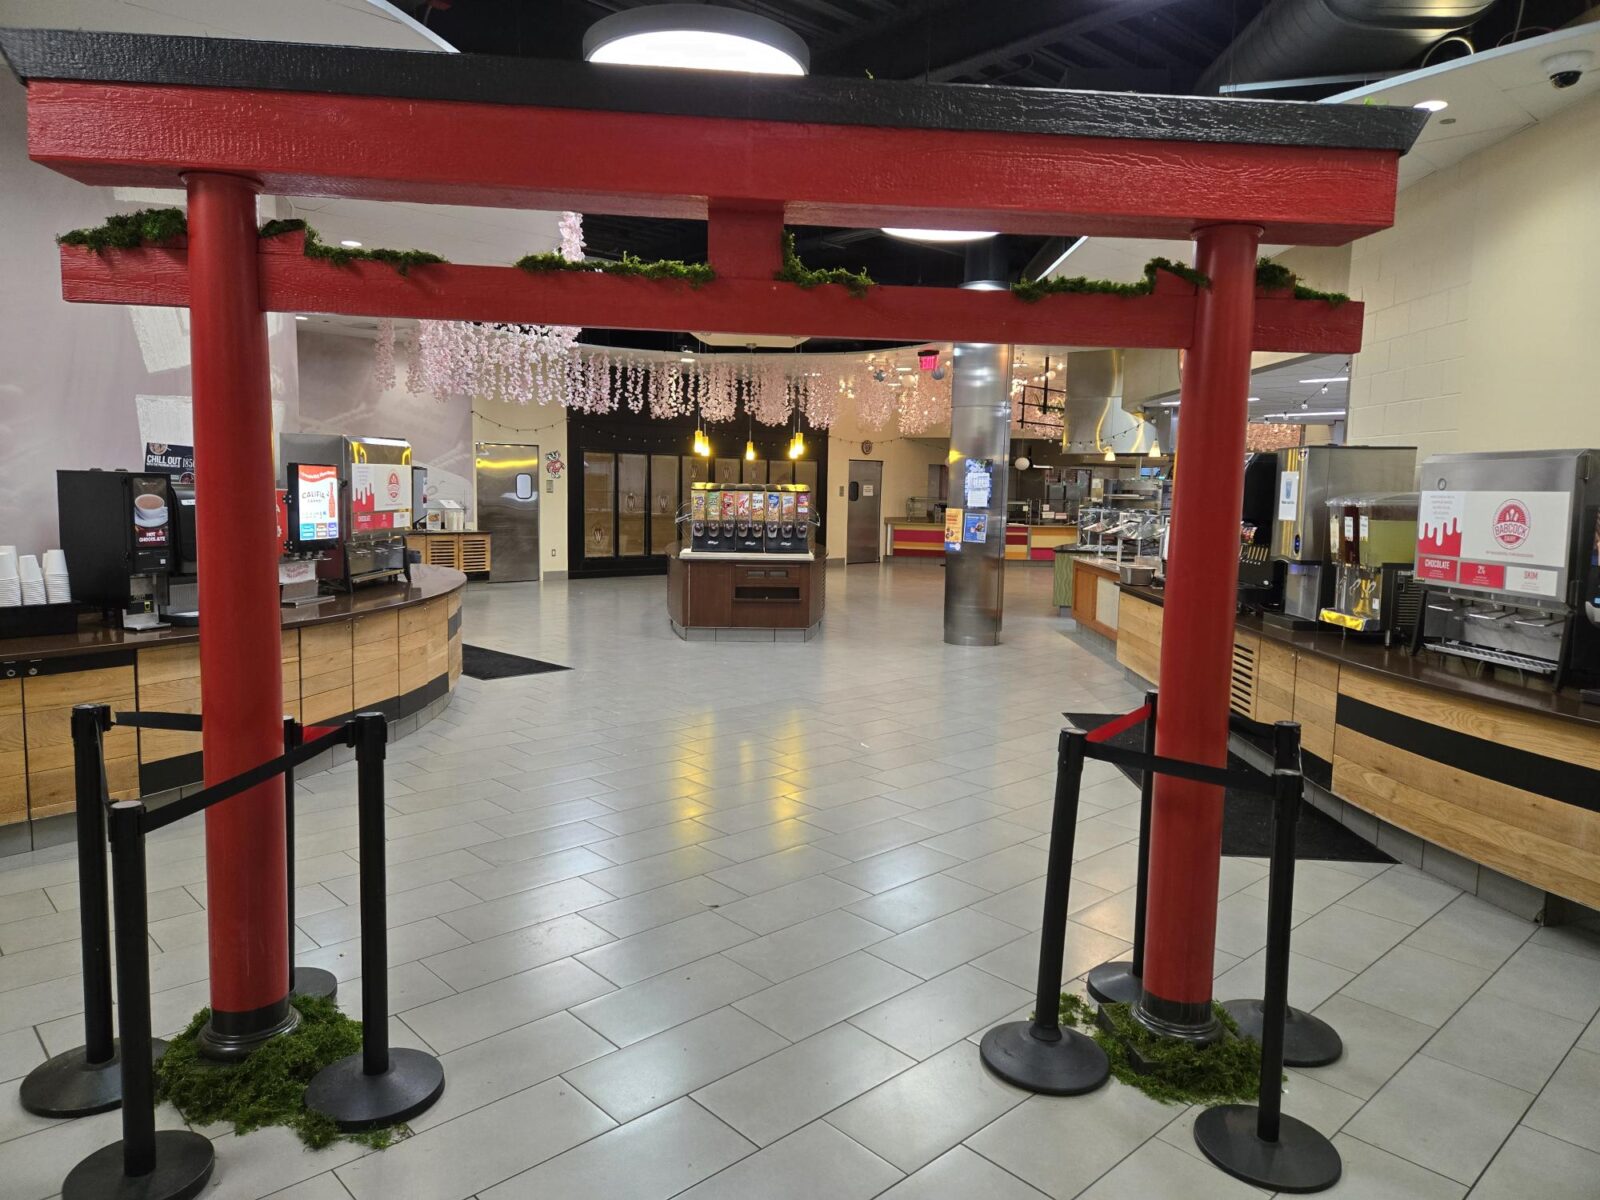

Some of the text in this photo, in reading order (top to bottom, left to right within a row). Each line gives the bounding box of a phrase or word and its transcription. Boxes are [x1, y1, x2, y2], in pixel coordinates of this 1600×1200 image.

[147, 455, 167, 465] CHILL
[167, 456, 182, 466] OUT
[182, 457, 194, 468] 185
[1494, 523, 1528, 538] BABCOCK
[1424, 558, 1450, 570] CHOCOLATE
[1477, 565, 1486, 575] 2%
[1524, 571, 1538, 580] SKIM
